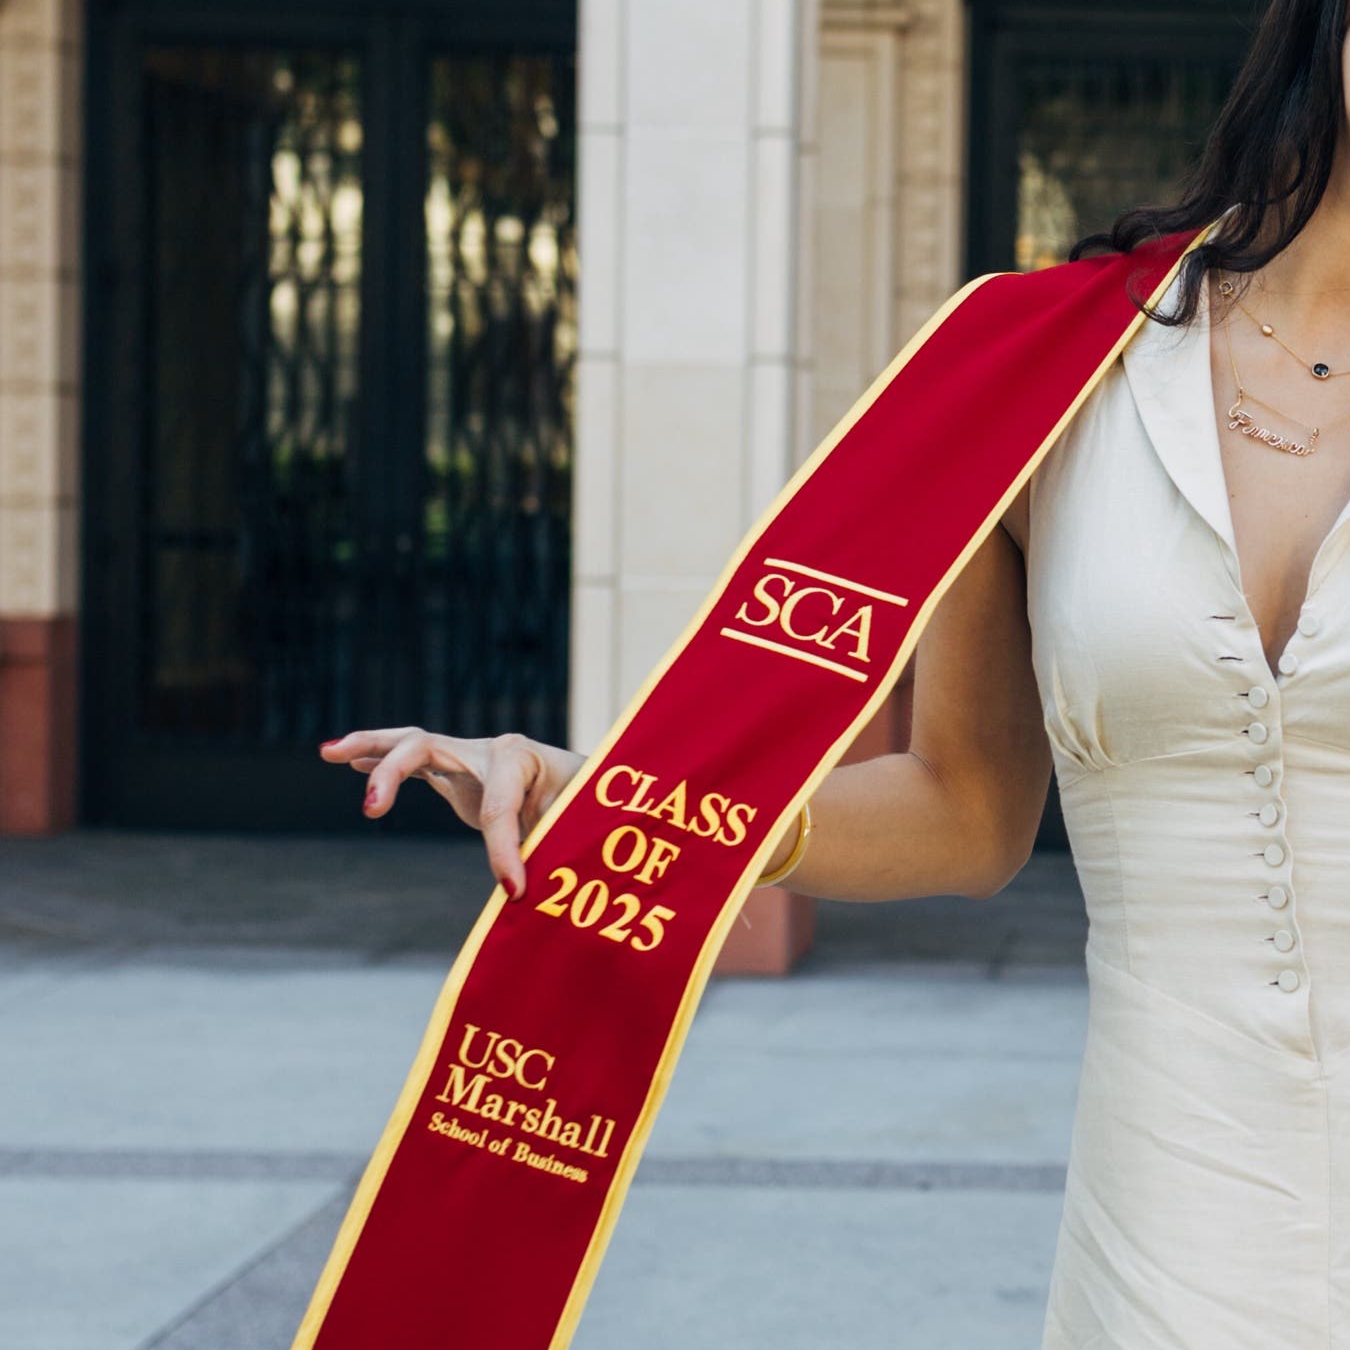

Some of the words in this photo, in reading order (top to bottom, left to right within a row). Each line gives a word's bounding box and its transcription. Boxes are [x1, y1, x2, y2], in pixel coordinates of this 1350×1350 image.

[735, 573, 873, 663] SCA
[595, 764, 758, 846] CLASS
[602, 825, 681, 885] OF
[535, 867, 677, 951] 2025
[458, 1023, 556, 1091] USC
[428, 1111, 489, 1148] School
[488, 1137, 513, 1156] of
[512, 1141, 589, 1183] Business
[435, 1063, 616, 1158] Marshall
